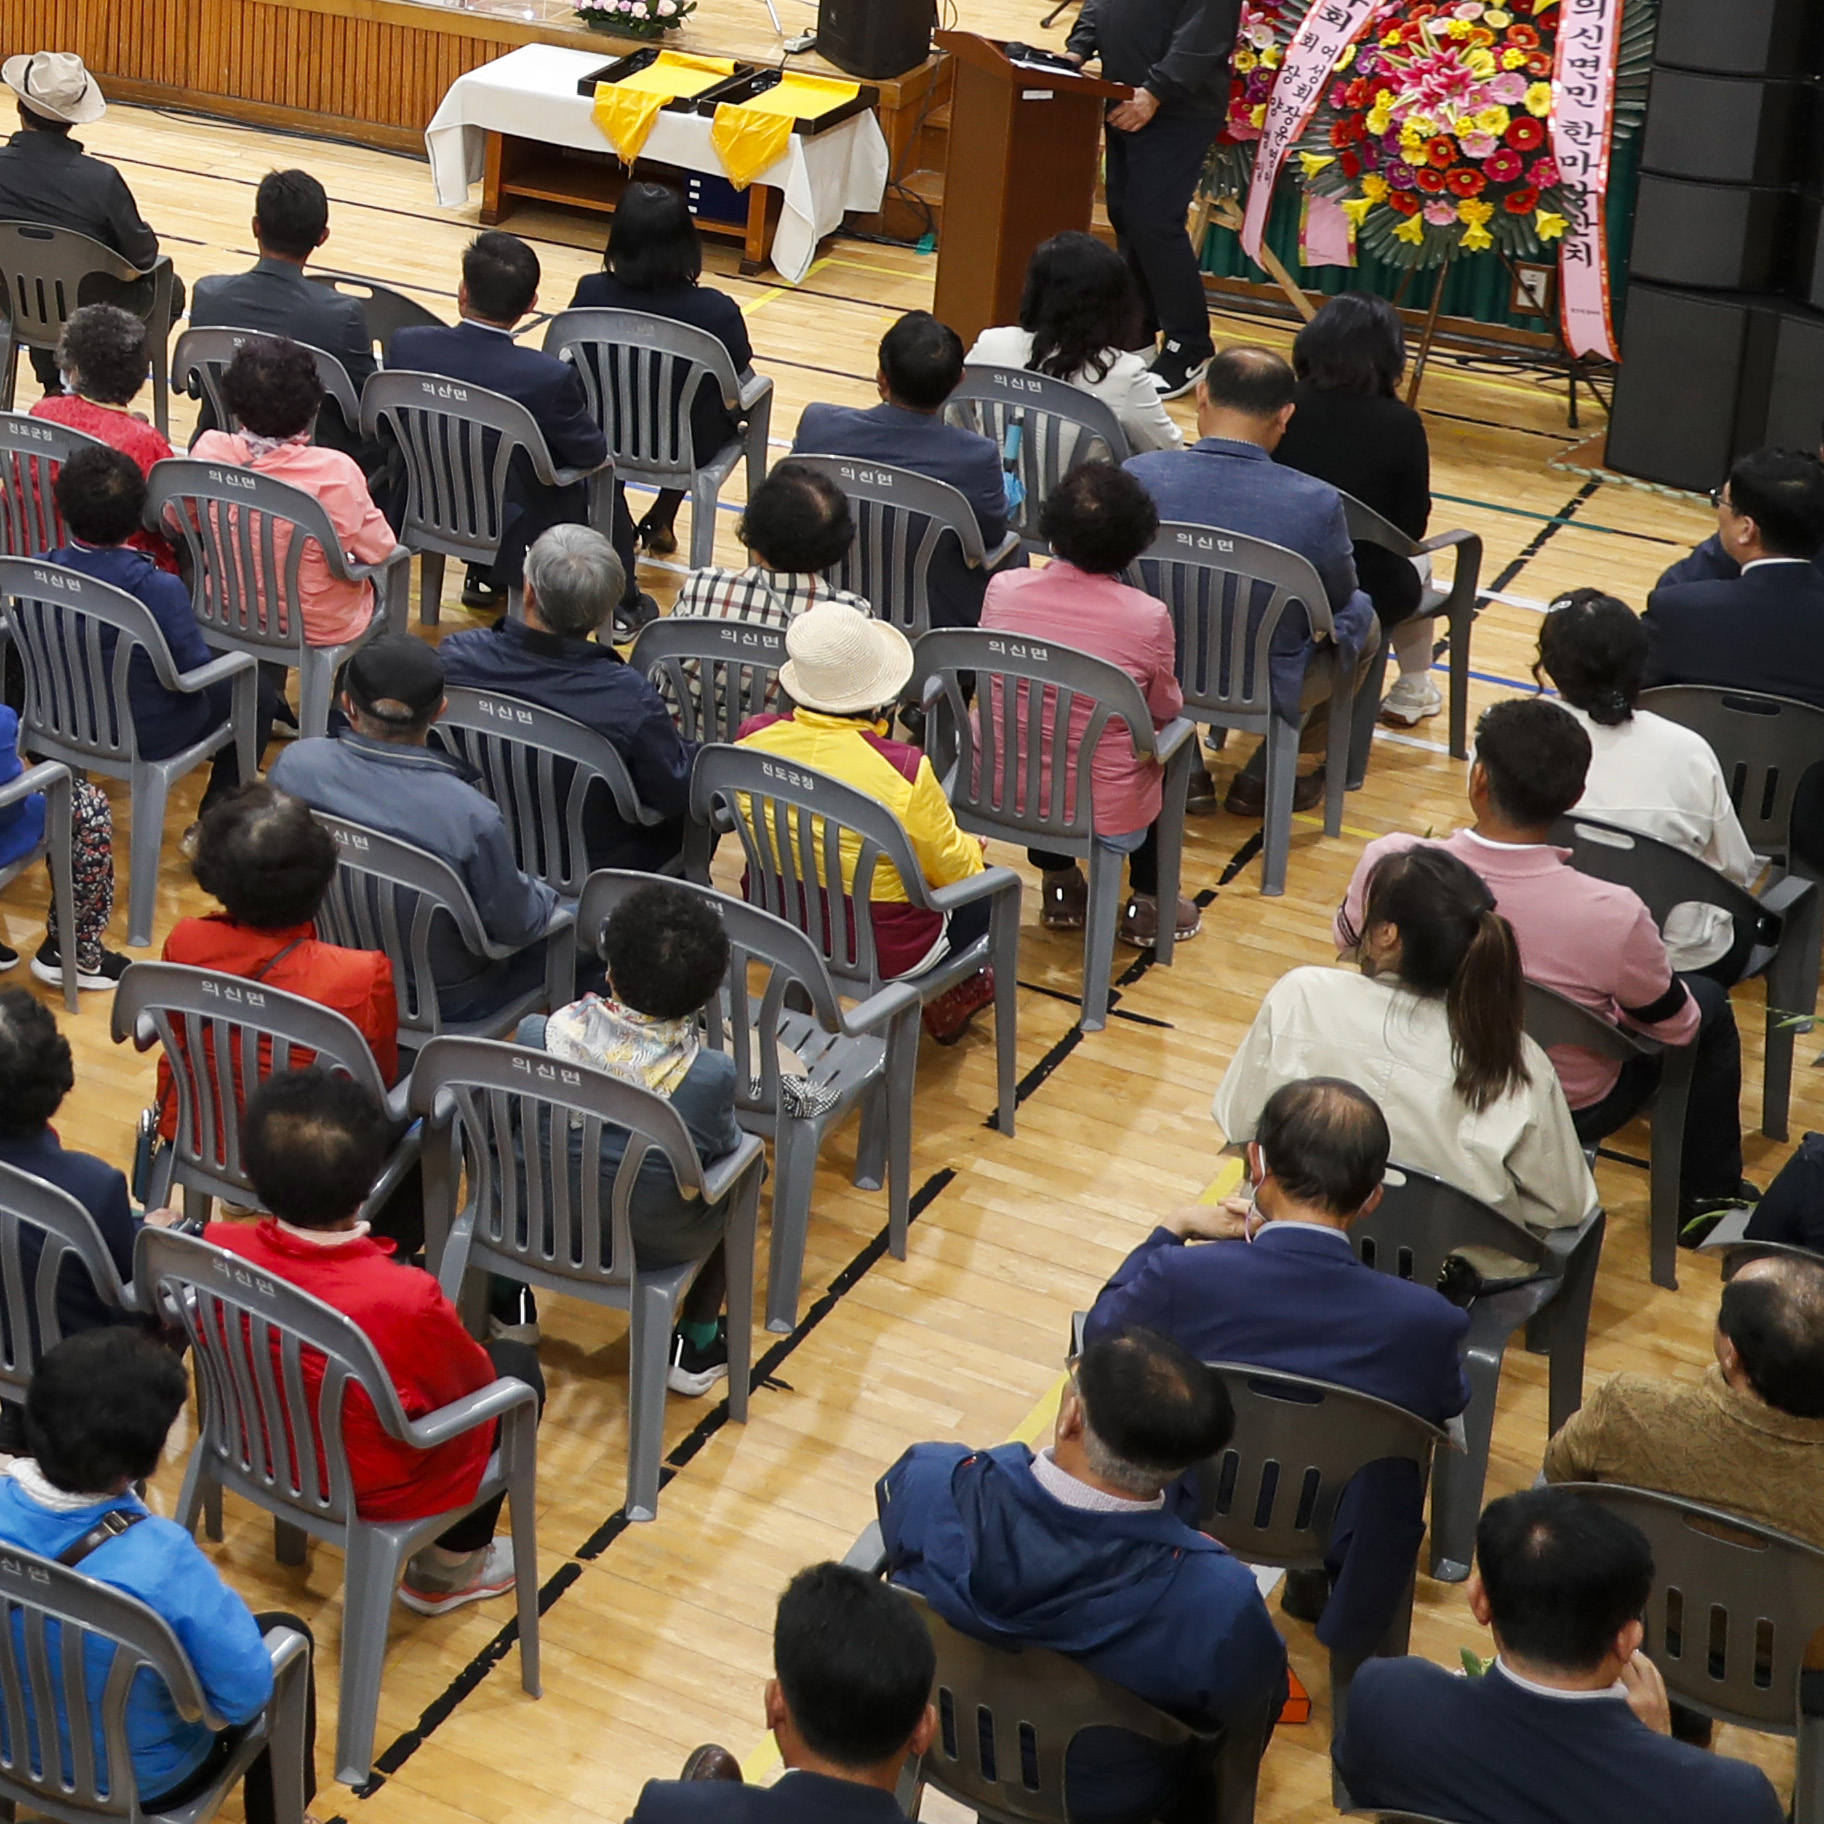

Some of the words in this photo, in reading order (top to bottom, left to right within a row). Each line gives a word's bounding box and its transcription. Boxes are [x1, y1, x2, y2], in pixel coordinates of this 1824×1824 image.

[422, 382, 468, 402] 의신면
[993, 373, 1043, 393] 의신면
[8, 421, 53, 442] 진도군청
[1176, 532, 1234, 553] 의신면
[720, 628, 780, 649] 의신면
[989, 640, 1049, 661] 의신면
[478, 699, 534, 726] 의신면
[761, 761, 815, 791] 진도군청
[202, 980, 266, 1008] 의신면
[512, 1056, 582, 1087] 의신면
[212, 1257, 276, 1298] 의신면
